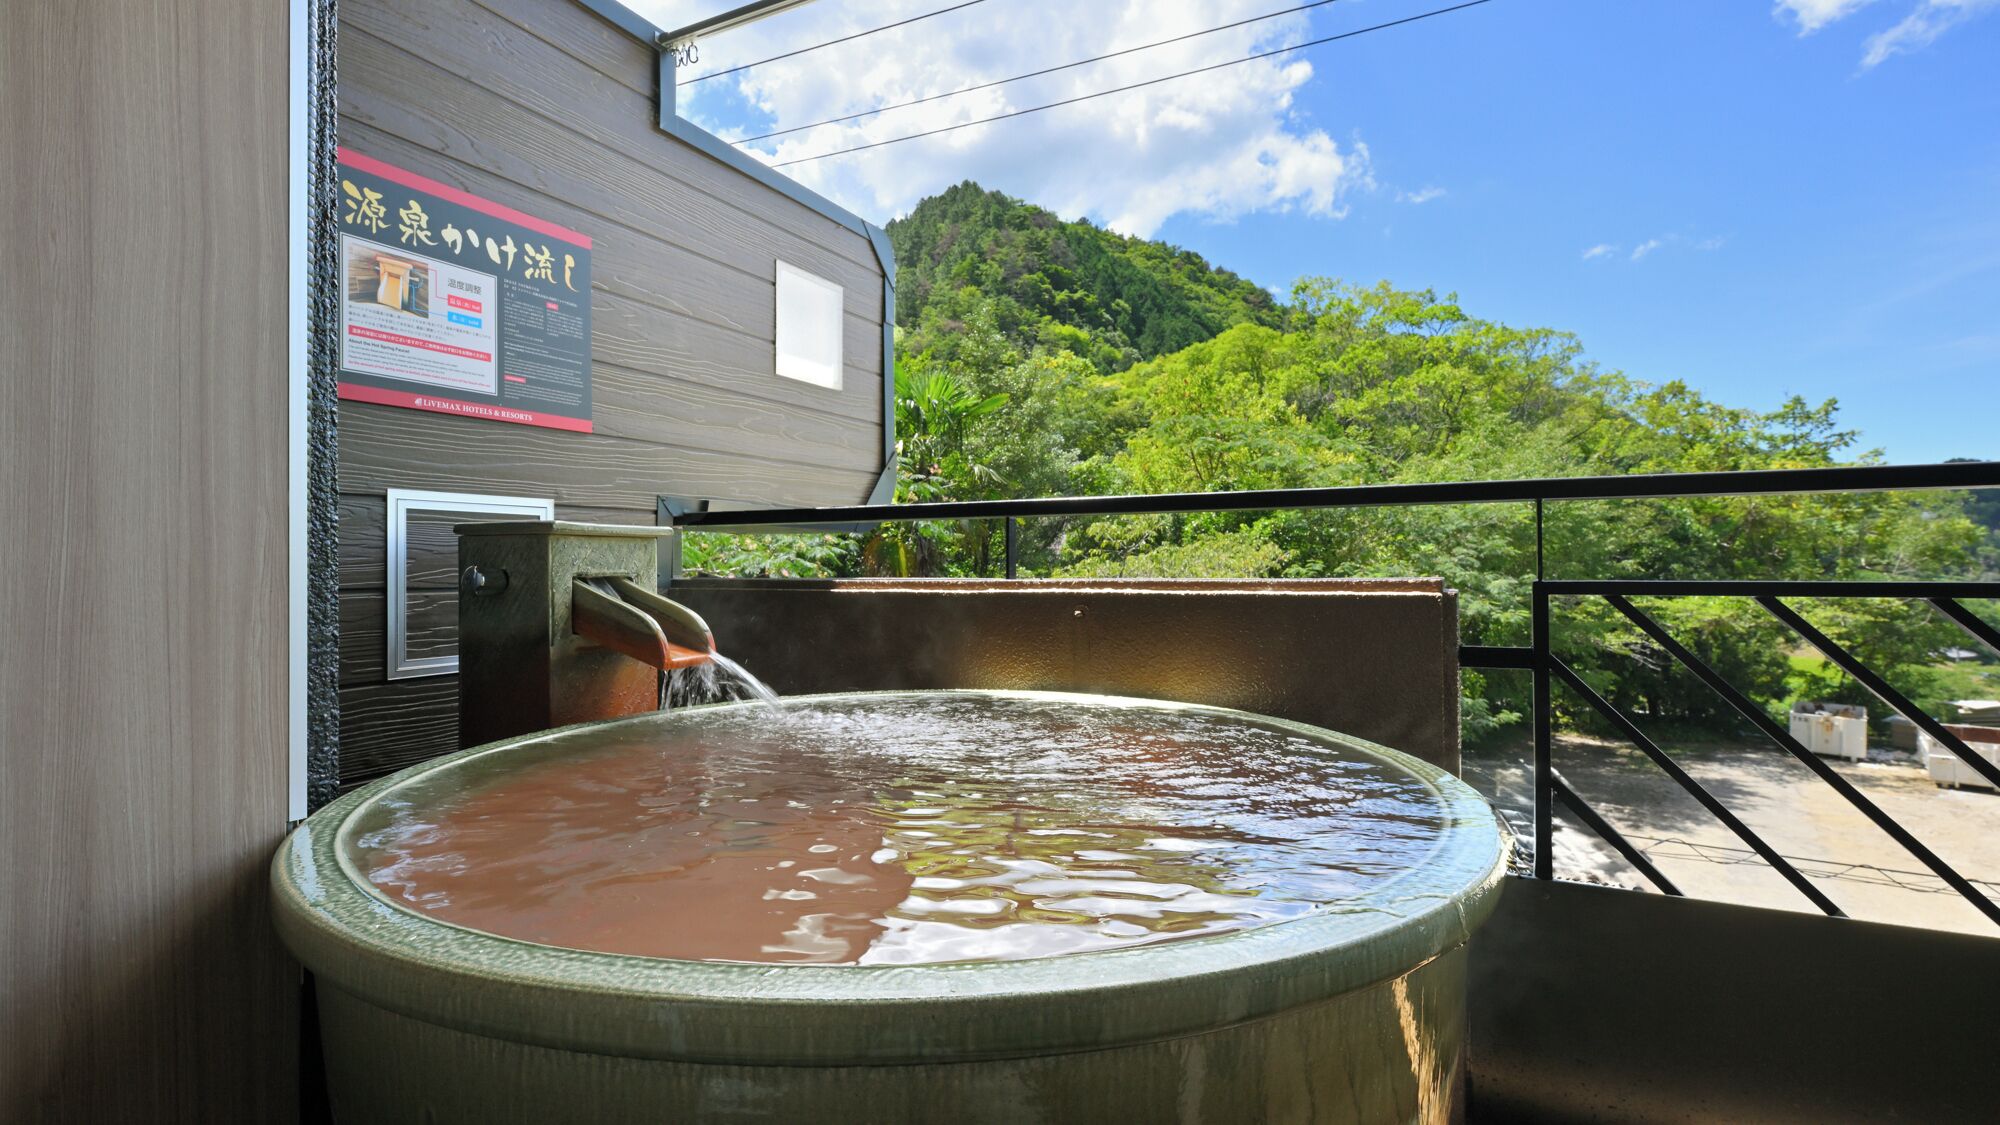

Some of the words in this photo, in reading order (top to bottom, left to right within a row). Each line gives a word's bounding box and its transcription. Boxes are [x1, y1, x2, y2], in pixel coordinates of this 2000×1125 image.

[342, 179, 580, 293] 源泉かけ流し
[463, 405, 493, 416] HOTELS
[501, 411, 533, 421] RESORTS
